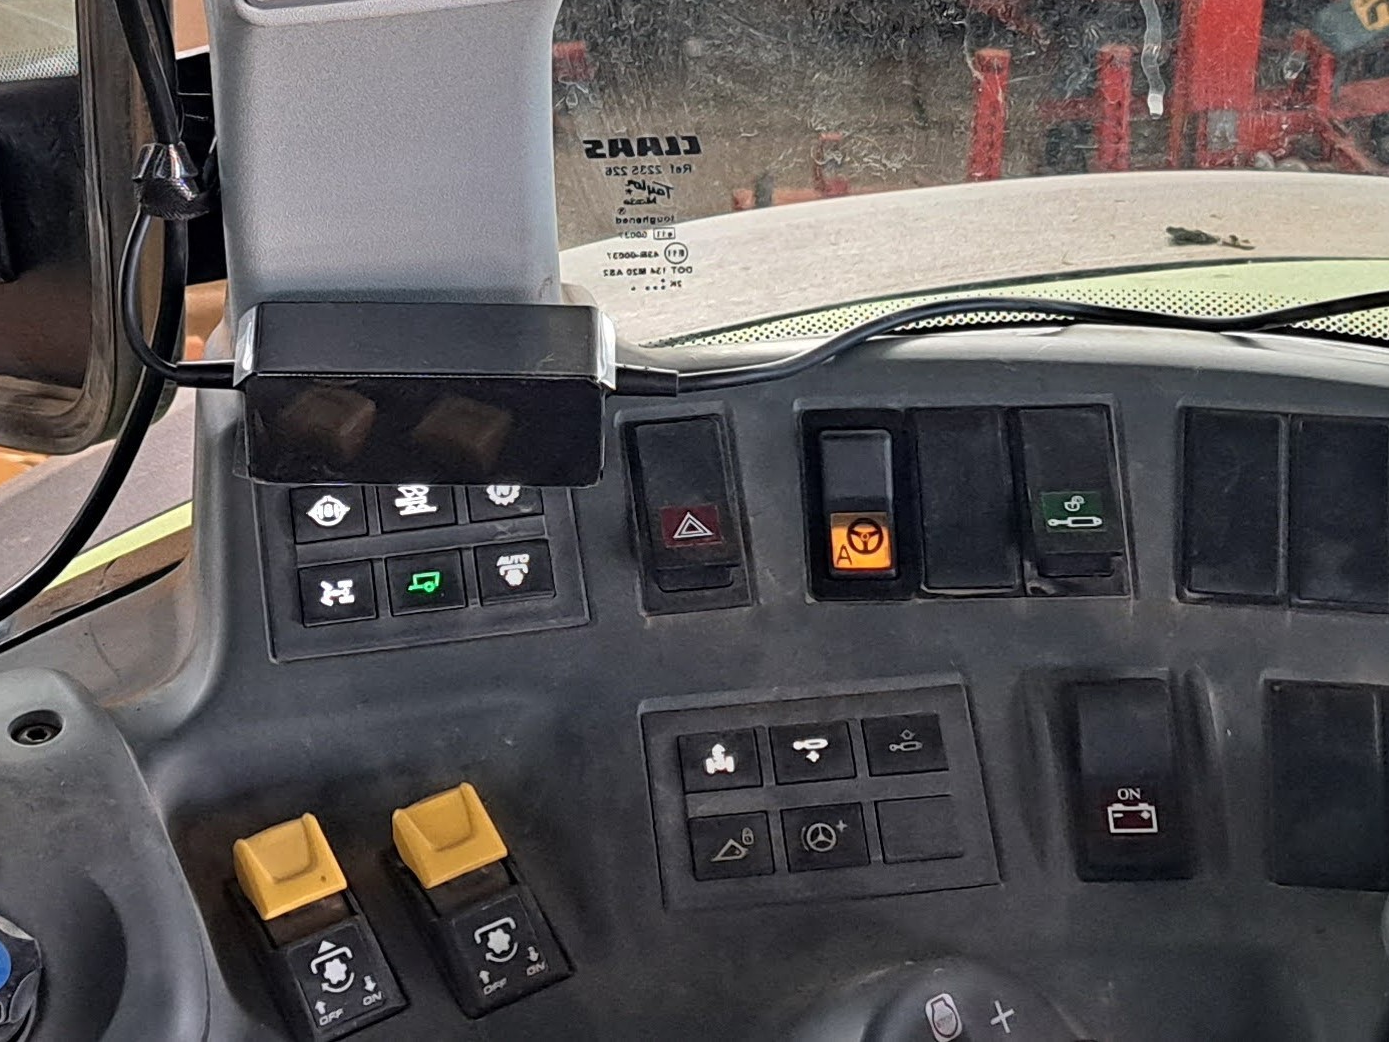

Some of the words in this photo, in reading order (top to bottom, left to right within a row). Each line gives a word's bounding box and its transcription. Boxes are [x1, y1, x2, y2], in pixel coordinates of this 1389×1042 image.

[496, 553, 530, 566] AUTO
[836, 544, 853, 566] A
[1117, 787, 1141, 800] ON
[526, 961, 547, 976] ON
[482, 977, 507, 996] OFF
[363, 991, 382, 1006] ON
[319, 1008, 344, 1026] OFF
